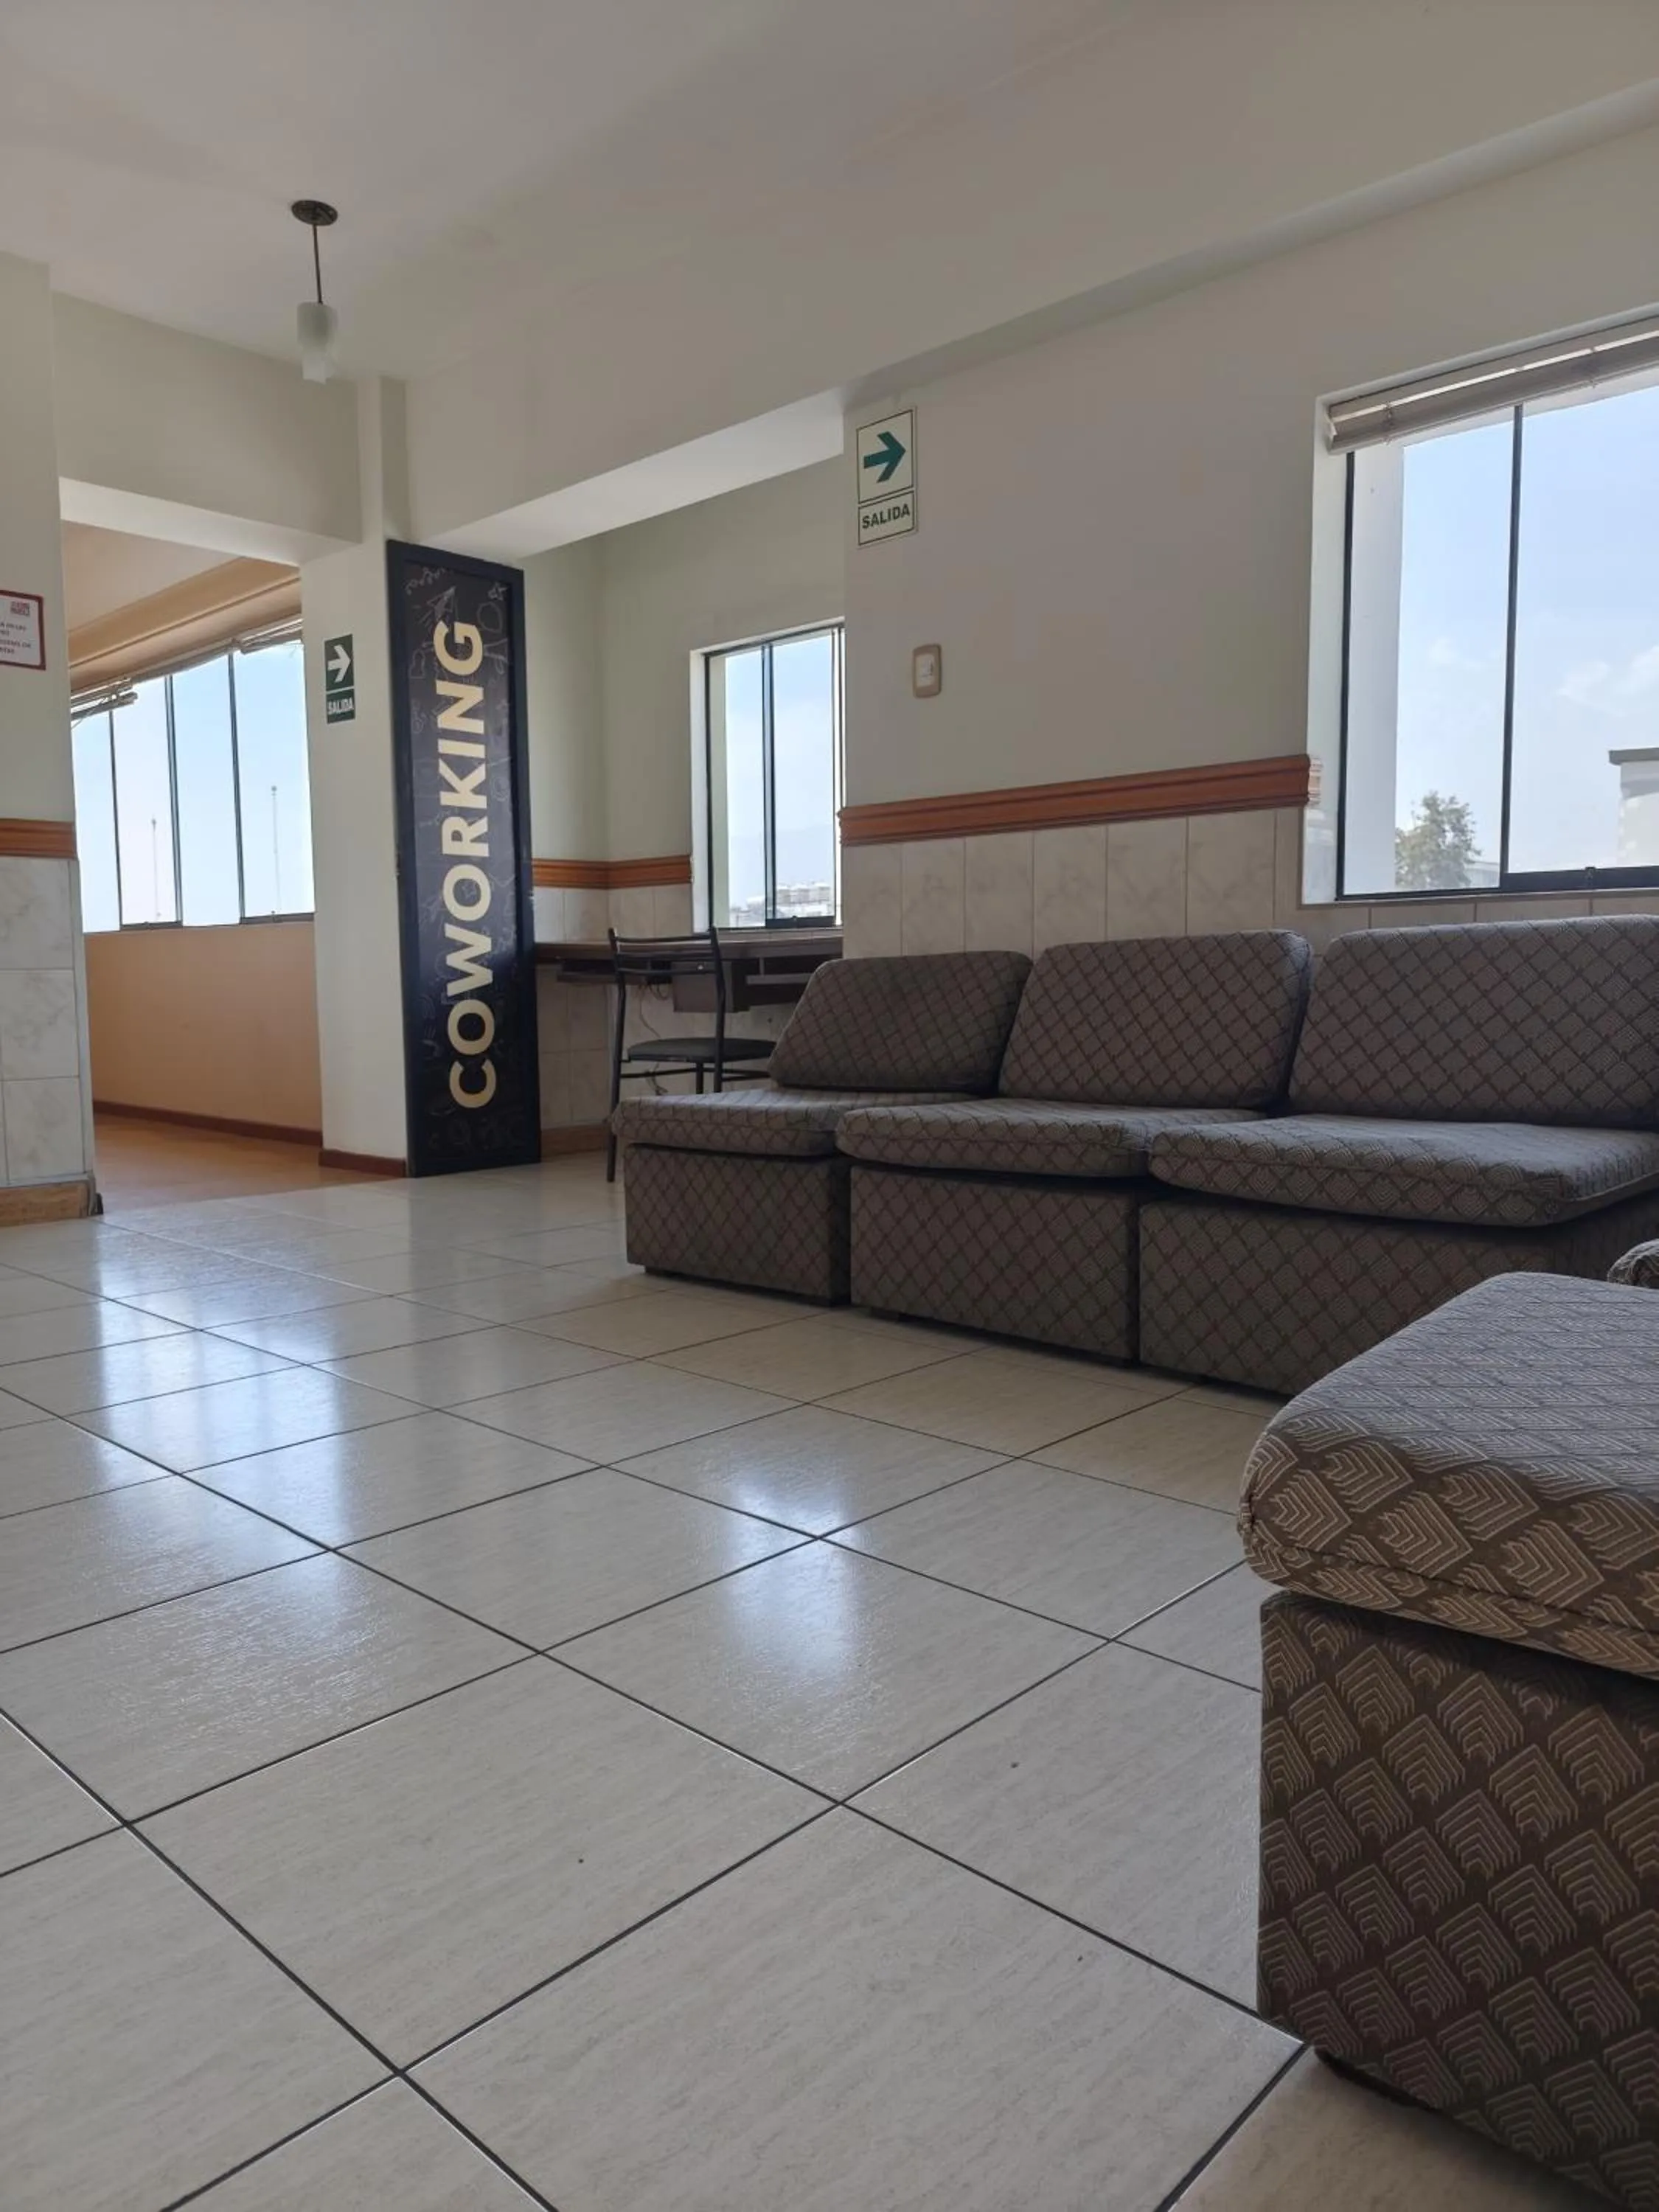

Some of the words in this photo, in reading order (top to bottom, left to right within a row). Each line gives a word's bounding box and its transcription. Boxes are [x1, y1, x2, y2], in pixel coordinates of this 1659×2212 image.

[862, 503, 910, 529] SALIDA
[328, 697, 354, 714] SALIDA
[434, 620, 496, 1108] COWORKING
